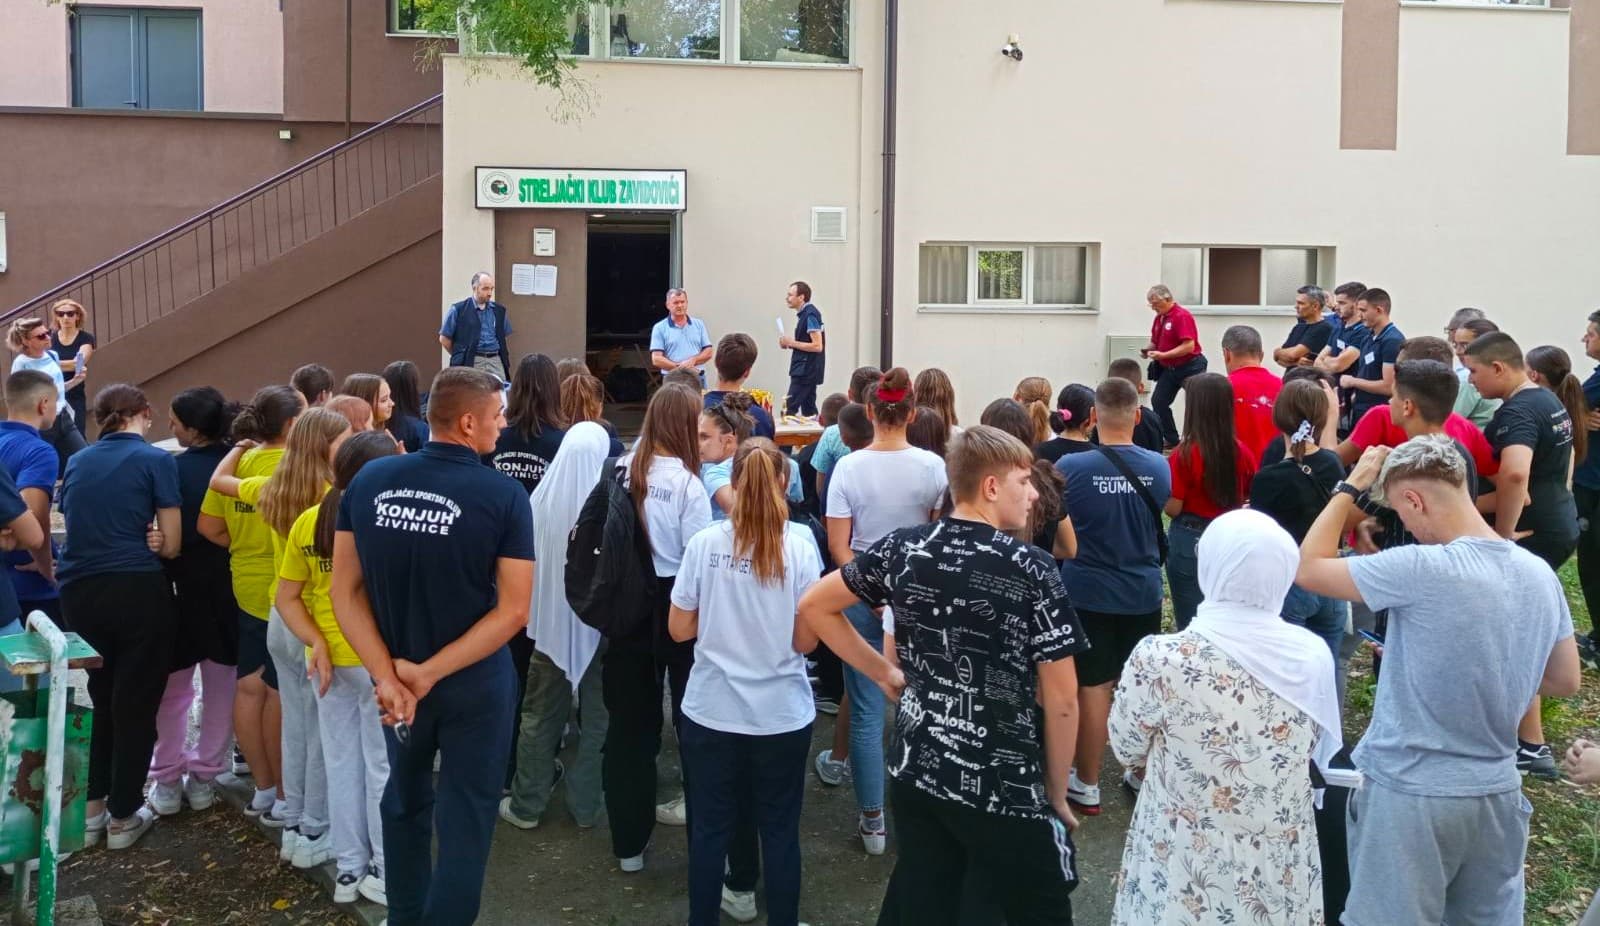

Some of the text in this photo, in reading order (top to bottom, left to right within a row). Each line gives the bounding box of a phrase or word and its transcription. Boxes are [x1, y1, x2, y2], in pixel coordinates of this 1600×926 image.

[518, 174, 585, 203] STRELJAČKI
[588, 179, 617, 204] KLUB
[620, 175, 680, 205] ZAVIDOVIĆI
[374, 487, 462, 518] STRELJAČKI SPORTSKI KLUB
[376, 502, 455, 525] KONJUH
[375, 516, 449, 535] ŽIVINICE
